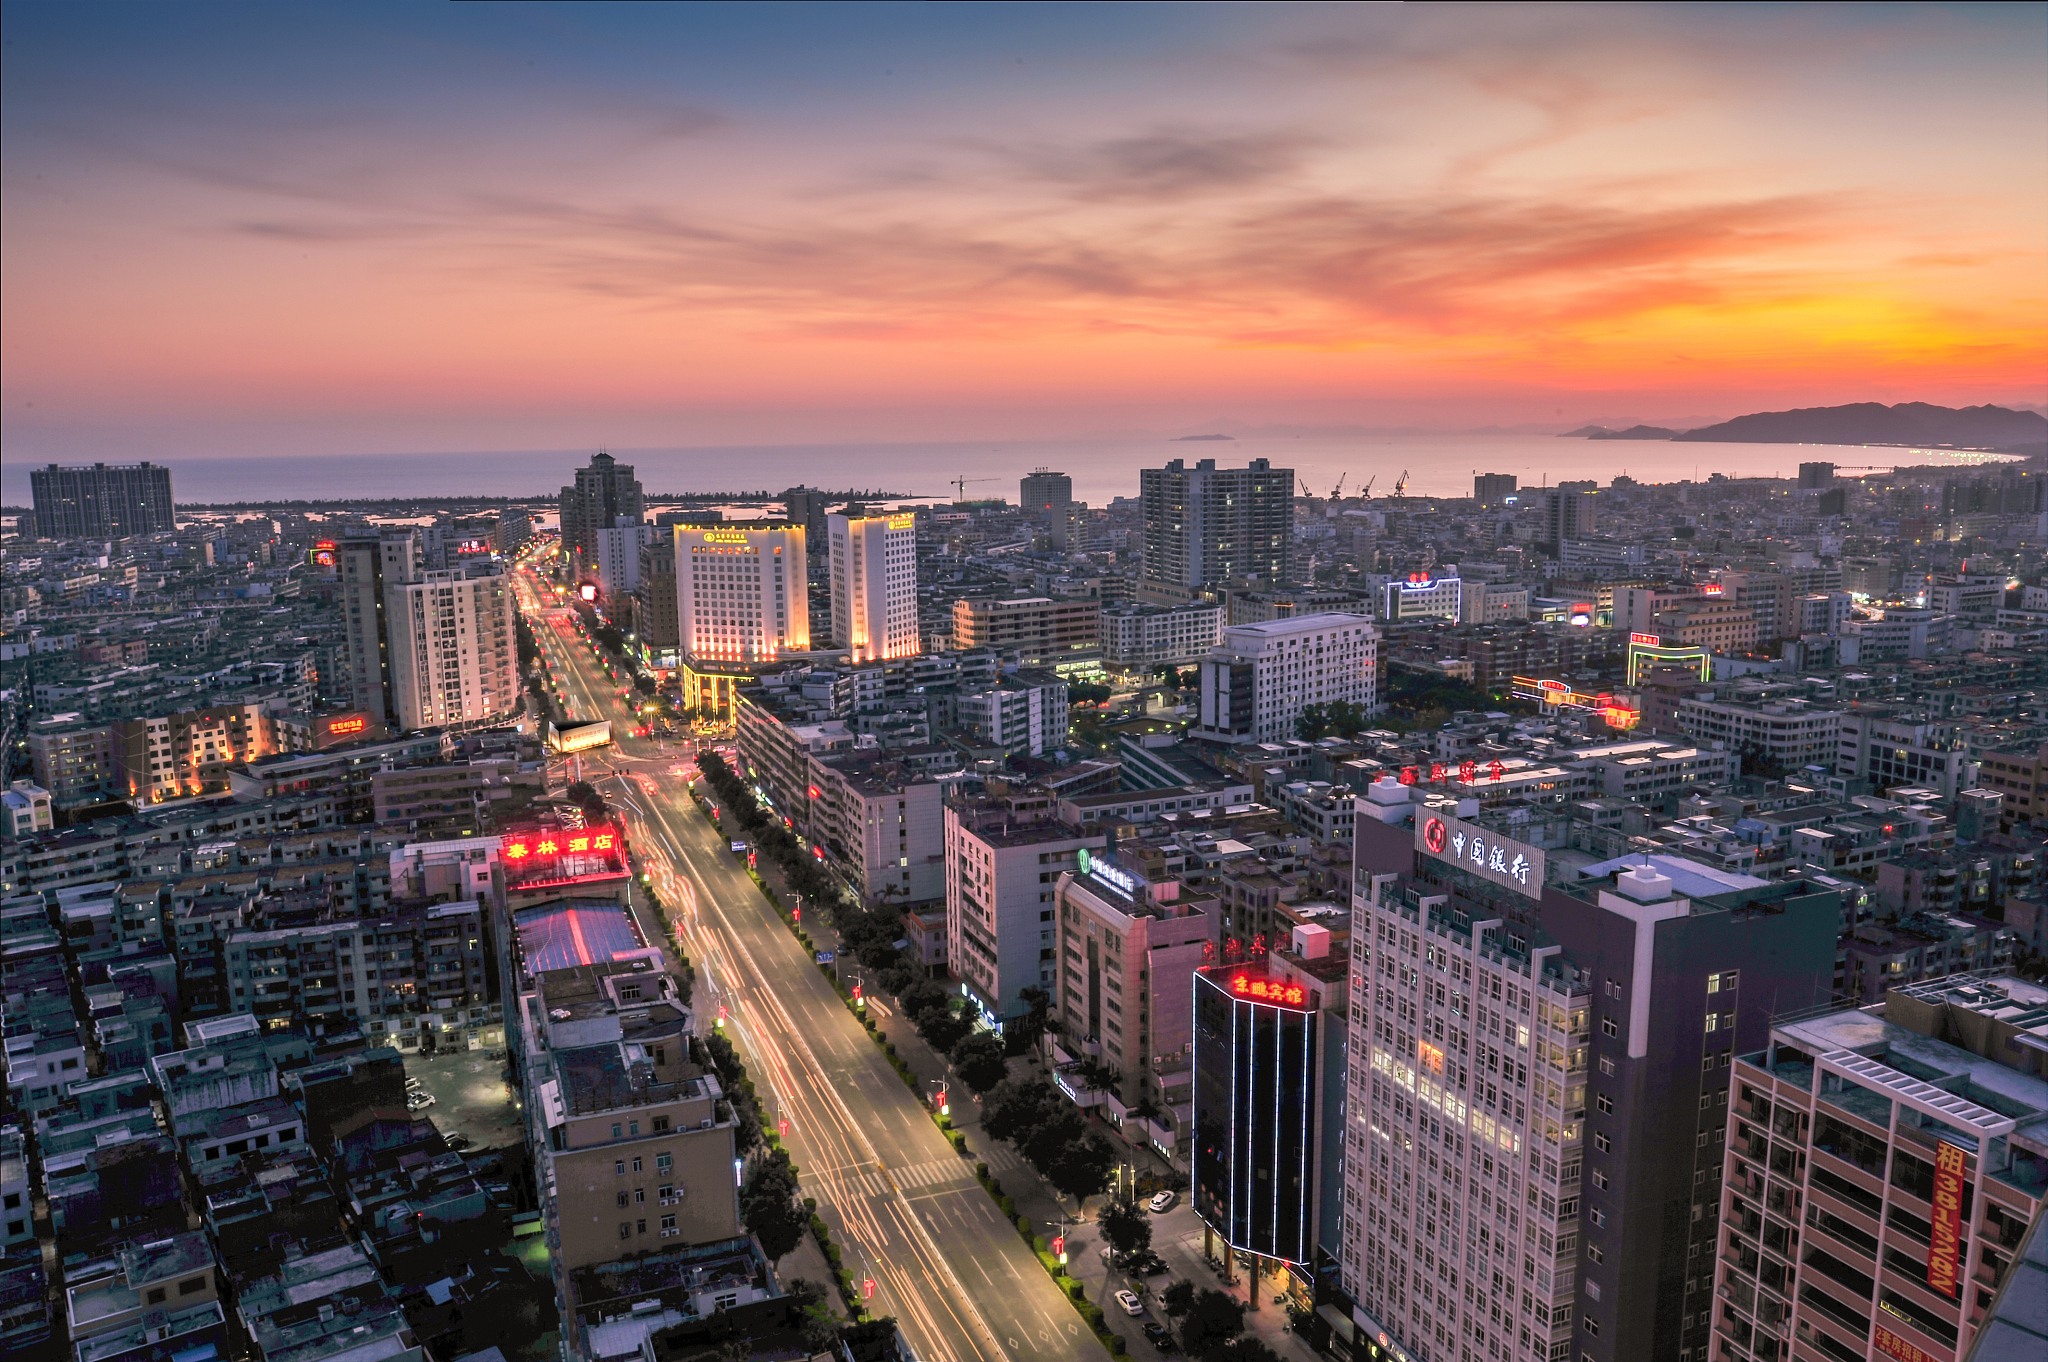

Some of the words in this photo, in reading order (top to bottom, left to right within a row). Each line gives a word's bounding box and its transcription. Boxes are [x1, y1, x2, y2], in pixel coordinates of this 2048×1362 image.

[507, 834, 614, 859] 泰林酒店
[1234, 976, 1303, 1004] 京鹏宾馆
